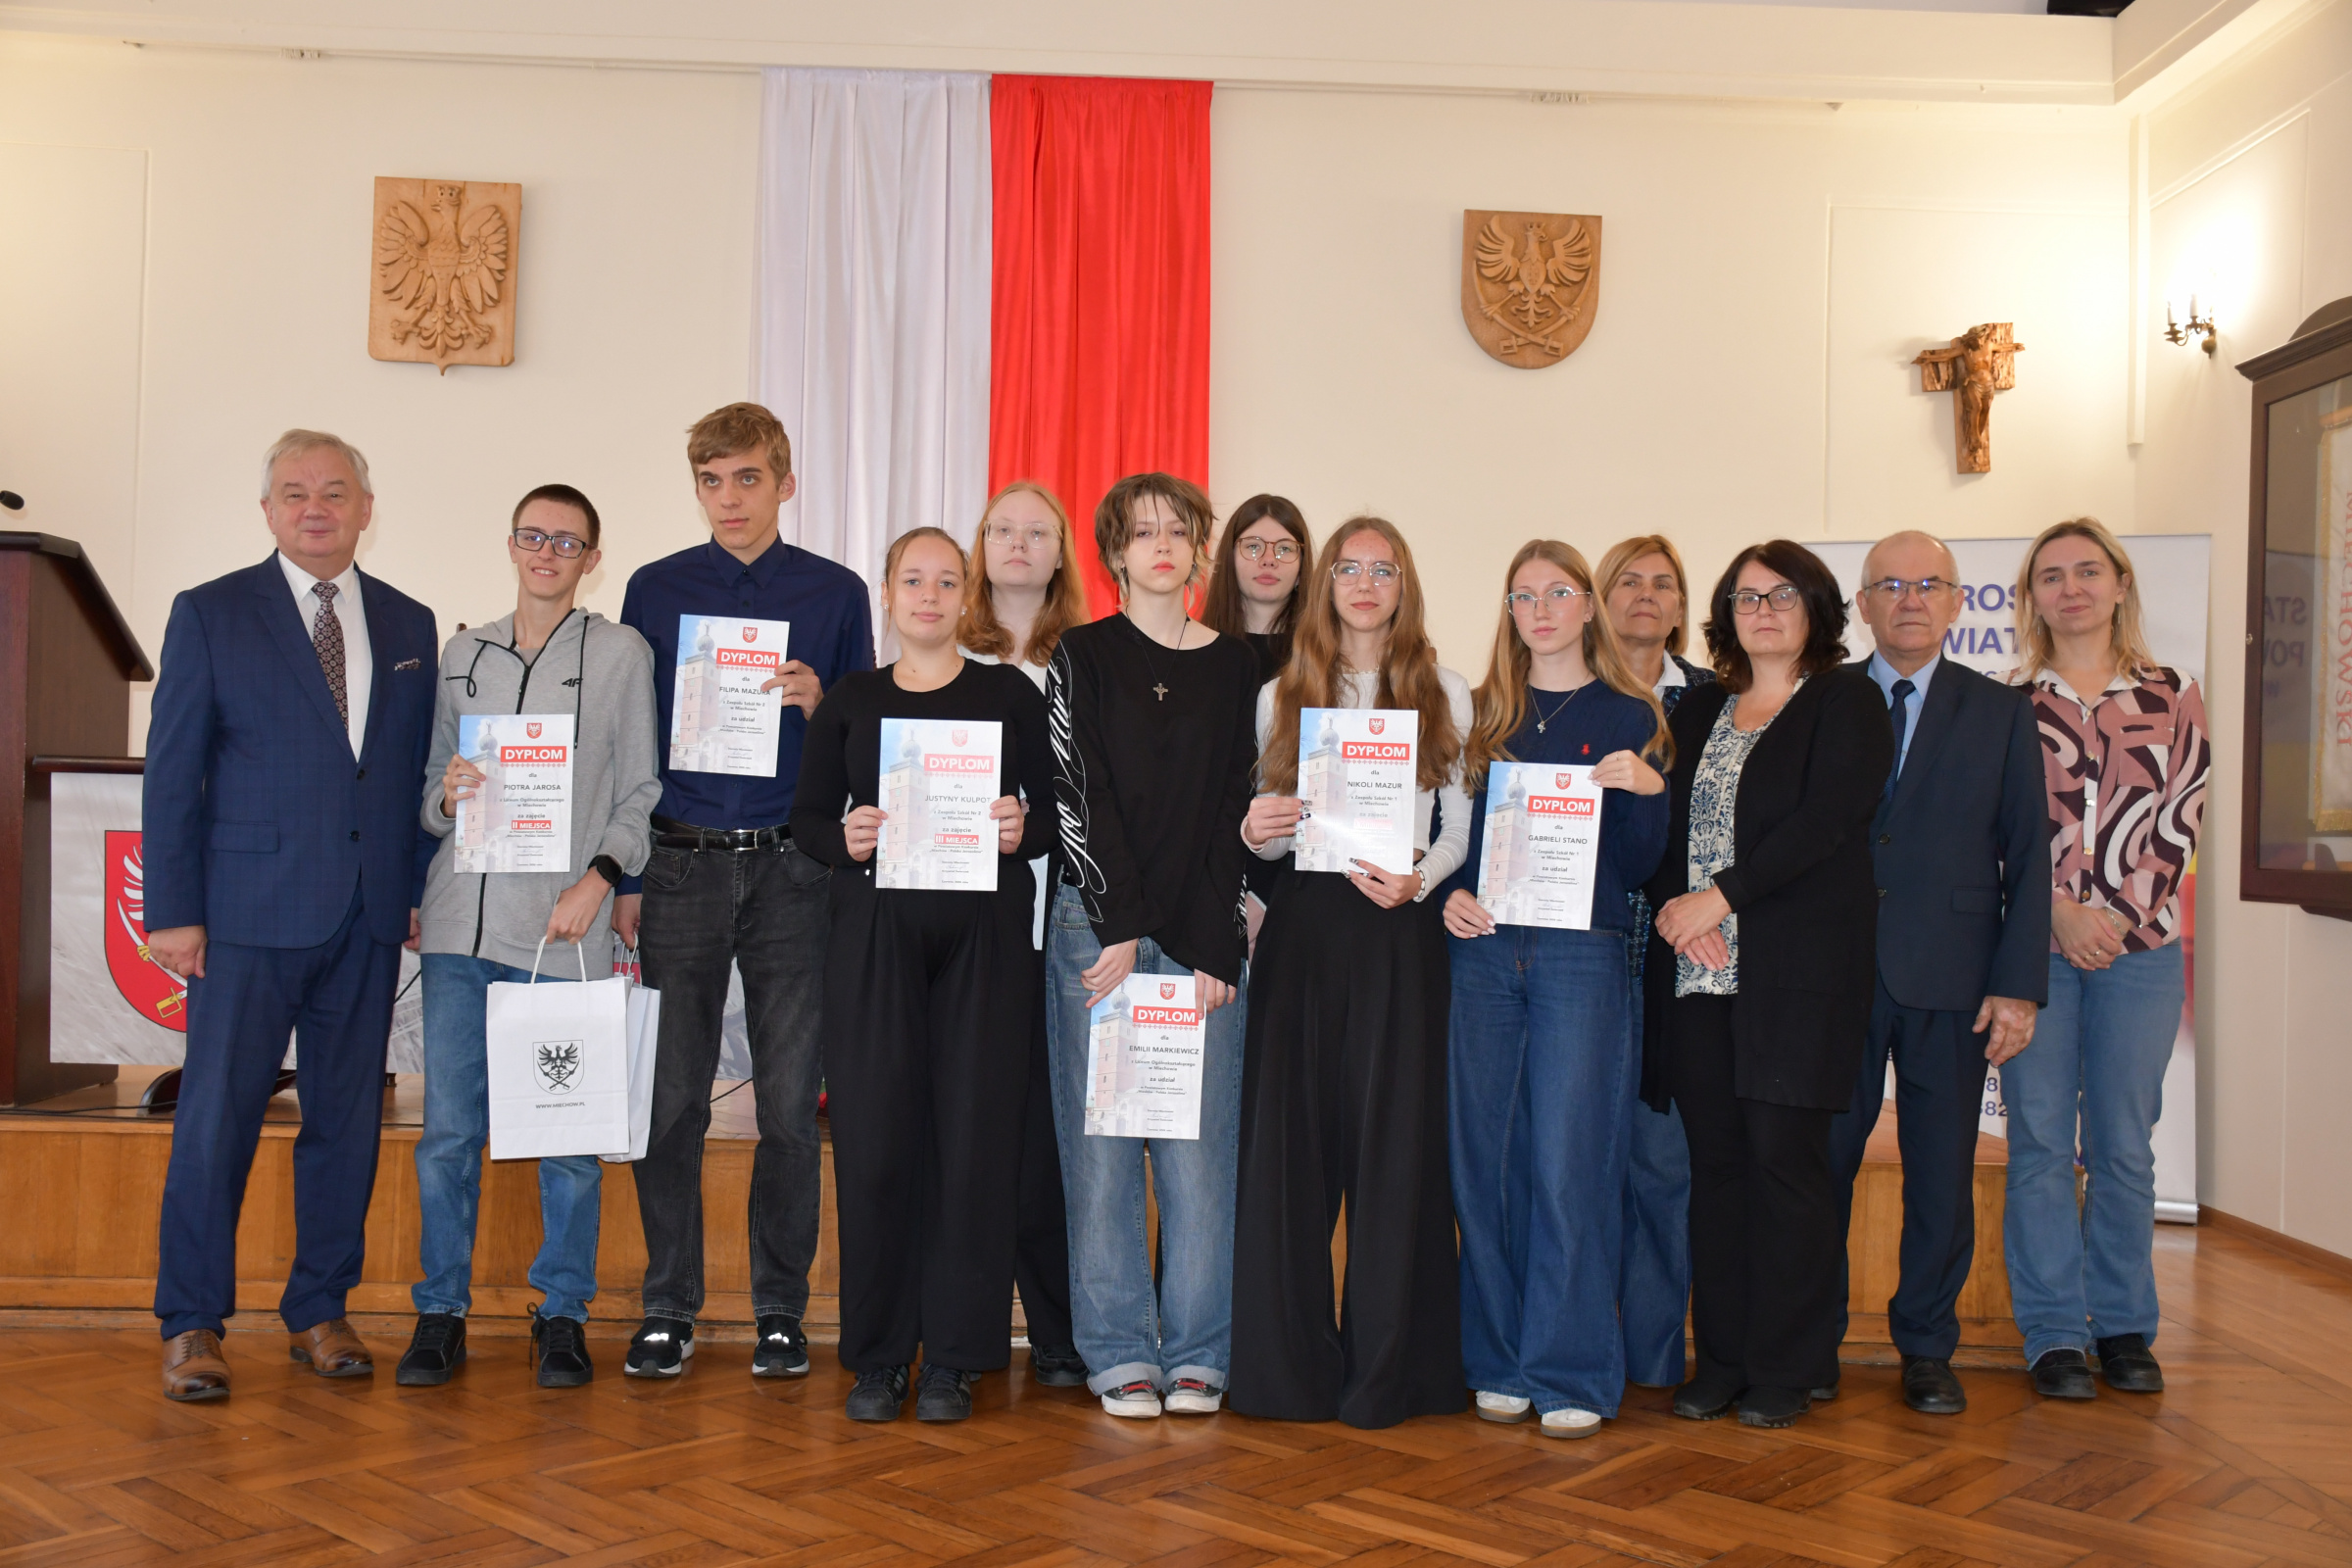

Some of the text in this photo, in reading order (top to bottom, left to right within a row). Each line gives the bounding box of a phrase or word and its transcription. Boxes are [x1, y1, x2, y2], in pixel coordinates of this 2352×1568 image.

[721, 651, 776, 665] DYPLOM
[505, 749, 564, 760] DYPLOM
[1347, 745, 1406, 758] DYPLOM
[929, 757, 990, 770] DYPLOM
[1533, 799, 1591, 813] DYPLOM
[1528, 834, 1561, 843] GABRIELI
[1138, 1009, 1196, 1023] DYPLOM
[1152, 1047, 1200, 1055] MARKIEWICZ
[1986, 1077, 1998, 1092] 8
[1980, 1101, 2007, 1117] 82
